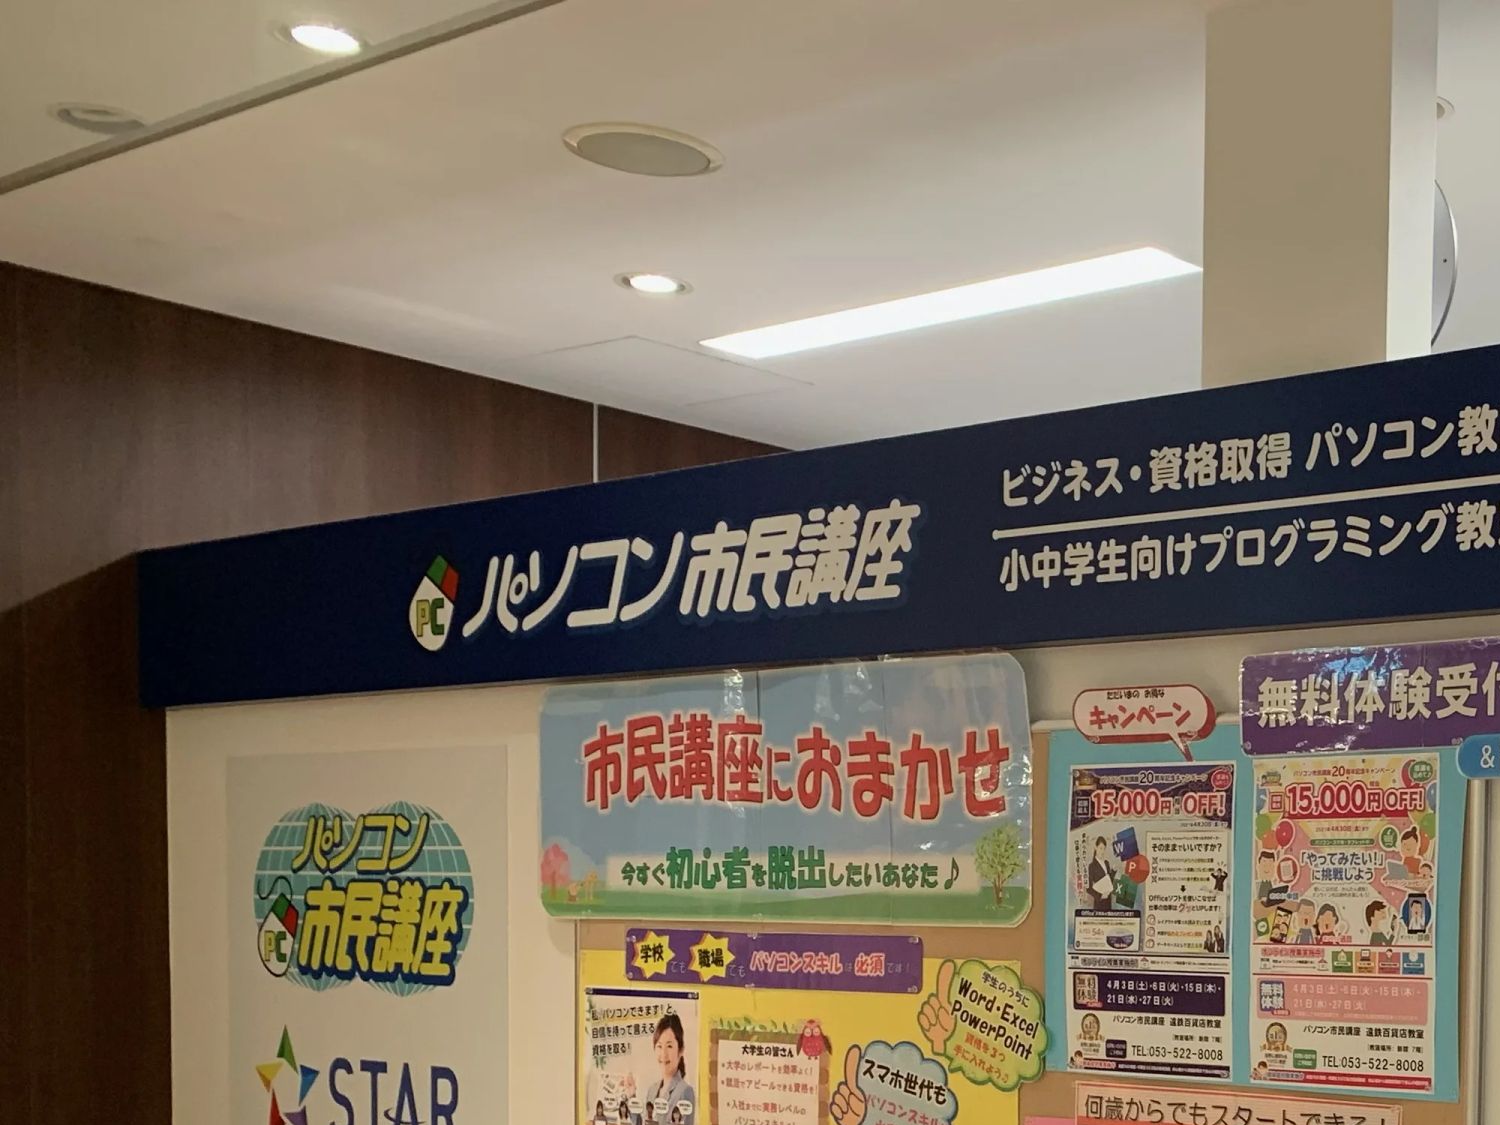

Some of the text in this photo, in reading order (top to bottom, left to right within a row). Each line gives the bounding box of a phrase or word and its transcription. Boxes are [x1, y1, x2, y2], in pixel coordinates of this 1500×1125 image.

[1002, 432, 1292, 507] ビジネス・資格取得
[461, 498, 922, 639] パソコン市民講座
[416, 598, 445, 638] PC
[1089, 702, 1192, 730] キャンペーン
[582, 712, 1010, 821] 市民講座におまかせ
[1383, 788, 1425, 810] OFF!
[291, 813, 430, 876] パソコン
[1311, 867, 1374, 882] に挑戦しよう
[264, 930, 288, 964] PC
[298, 877, 468, 982] 市民講座
[981, 971, 1030, 1008] 学生のうちに
[951, 999, 1033, 1061] PowerPoint
[1112, 1015, 1222, 1029] パソコン市民講座 遠鉄百貨店教室
[1303, 1024, 1425, 1040] パソコン市民講座 遠鉄百貨店教室
[741, 1043, 795, 1058] 大学生の皆さん
[1131, 1045, 1223, 1061] TEL:053-522-8008
[1322, 1055, 1425, 1073] TEL:053-522-8008
[861, 1058, 948, 1106] スマホ世代も
